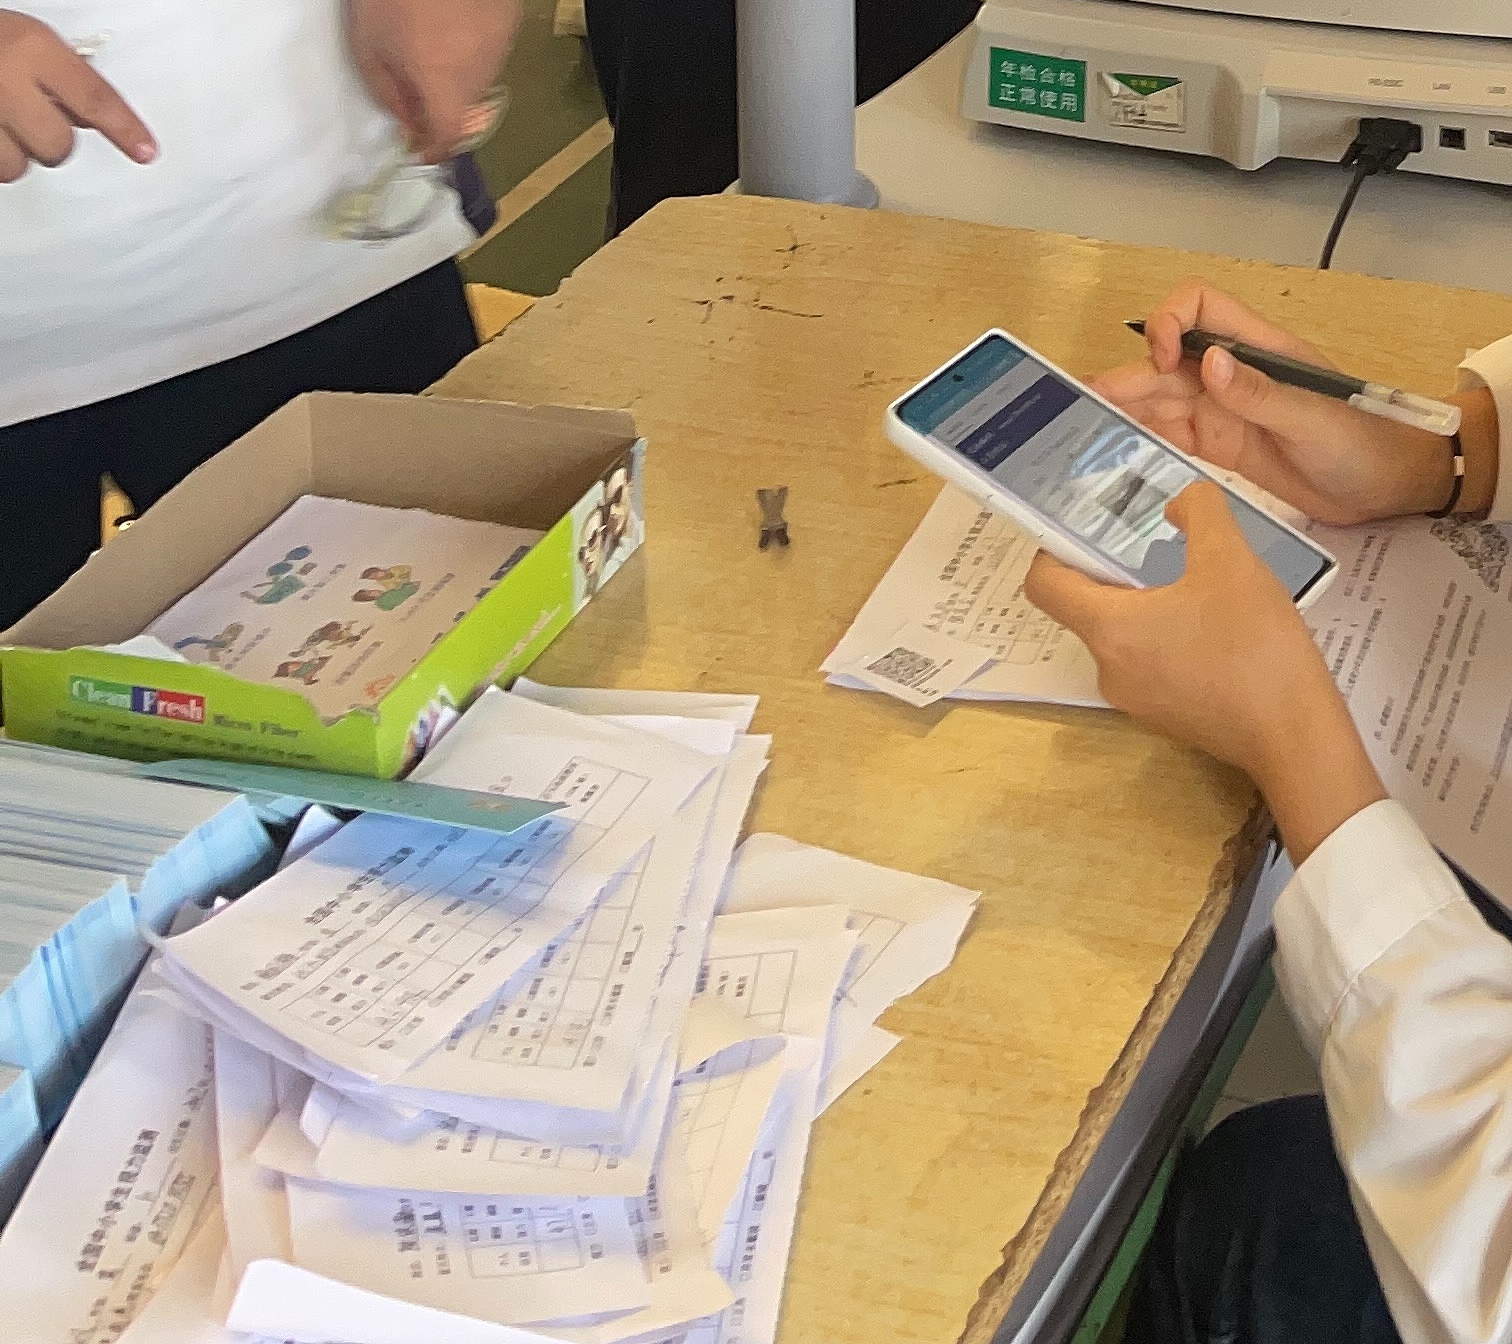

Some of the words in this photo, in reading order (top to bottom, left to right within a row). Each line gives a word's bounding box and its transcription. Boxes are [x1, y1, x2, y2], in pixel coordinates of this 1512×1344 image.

[999, 60, 1076, 87] 年检合格
[999, 83, 1078, 112] 正常使用
[72, 680, 131, 709] Clean
[142, 691, 204, 722] Fresh
